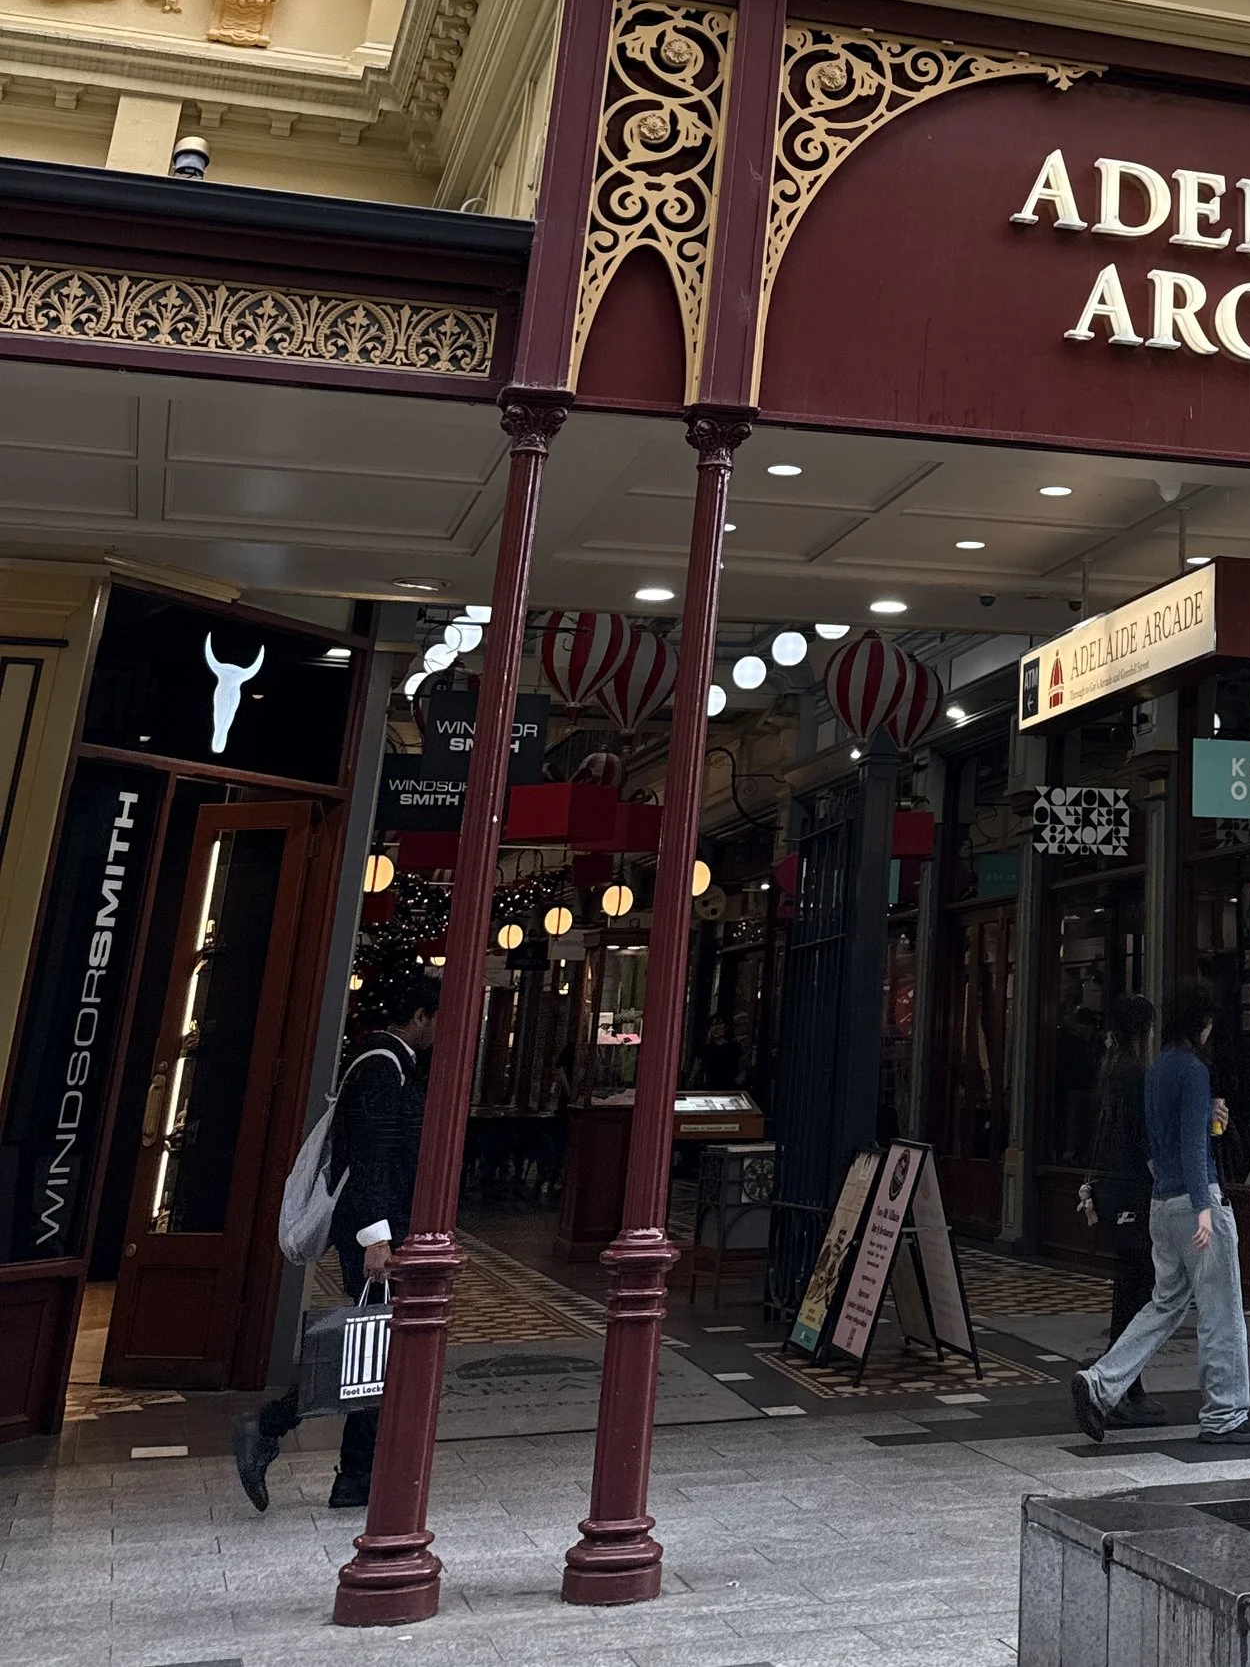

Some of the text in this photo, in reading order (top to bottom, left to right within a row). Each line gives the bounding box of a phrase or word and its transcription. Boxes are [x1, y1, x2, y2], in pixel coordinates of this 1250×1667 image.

[1070, 590, 1204, 681] ADELAIDE ARCADE
[1024, 667, 1038, 690] ATM
[436, 720, 538, 738] WINOR
[400, 794, 460, 806] SMITH
[342, 1387, 361, 1397] Foot
